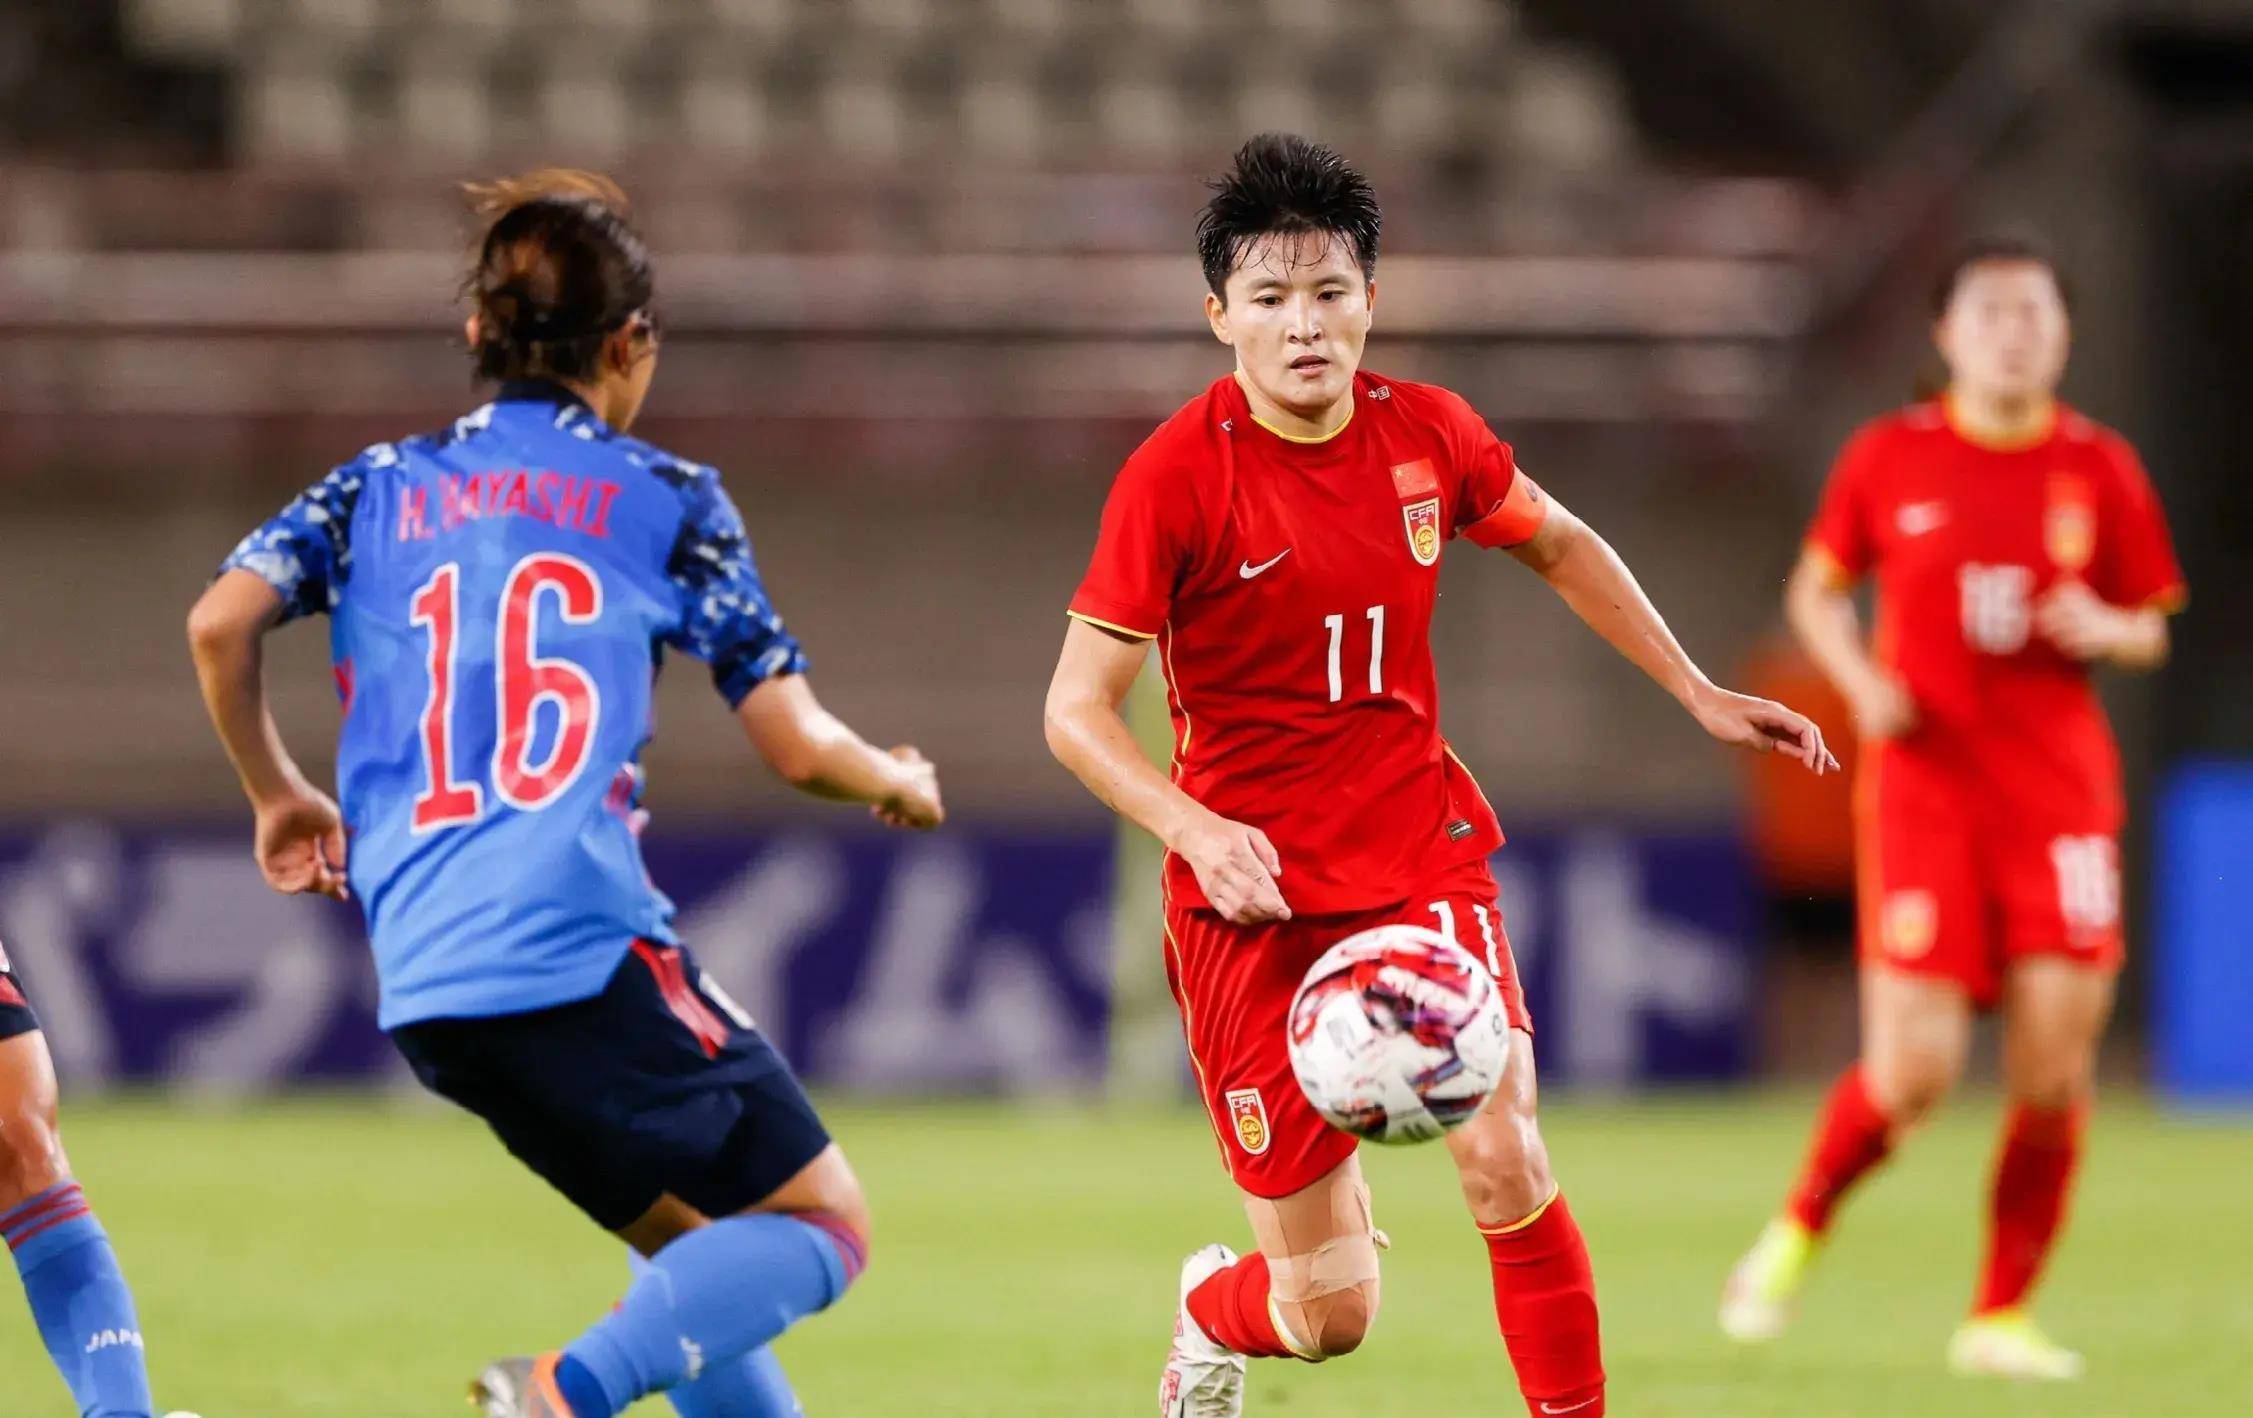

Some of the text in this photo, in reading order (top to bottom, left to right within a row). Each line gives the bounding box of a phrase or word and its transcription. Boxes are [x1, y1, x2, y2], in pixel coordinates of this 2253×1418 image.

[1408, 504, 1435, 521] CFA
[410, 552, 603, 834] 16
[1325, 604, 1385, 702] 11
[1428, 900, 1502, 977] 11
